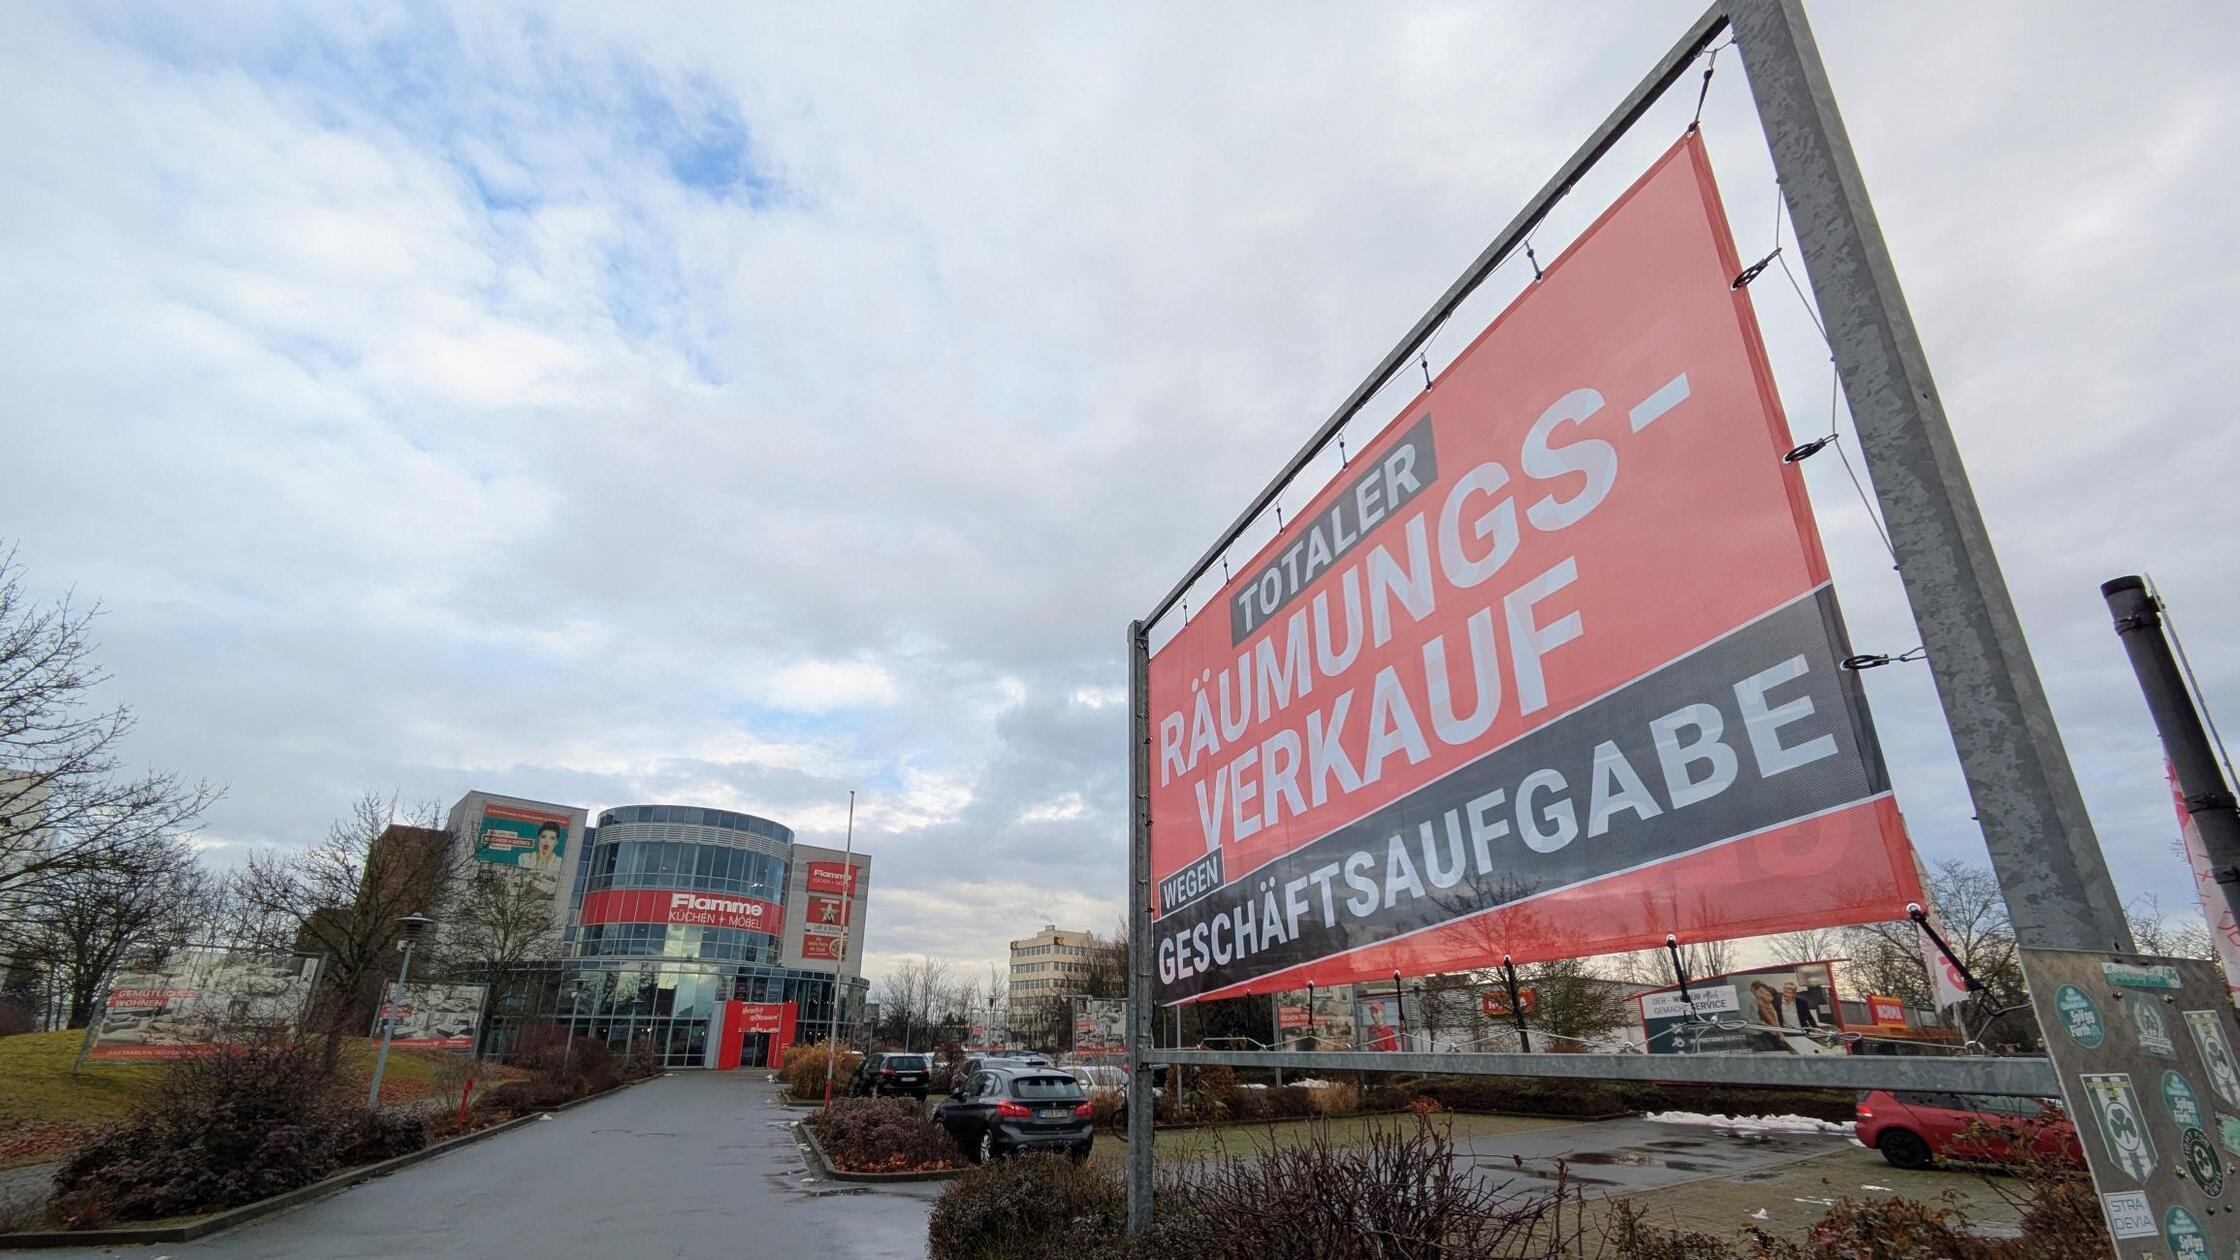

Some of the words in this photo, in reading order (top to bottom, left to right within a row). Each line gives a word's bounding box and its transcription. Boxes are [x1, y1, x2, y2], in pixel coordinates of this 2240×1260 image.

[1238, 443, 1421, 633] TOTALER
[1160, 371, 1691, 788] RÄUMUNGS-
[1194, 554, 1584, 853] VERKAUF
[1159, 653, 1839, 985] GESCHÄFTSAUFGABE
[670, 893, 763, 917] Flamme
[1163, 855, 1218, 909] WEGEN
[668, 909, 715, 924] KÜCHEN
[728, 914, 761, 929] MÖBEL
[115, 999, 163, 1008] WOHNEN
[2110, 1199, 2145, 1212] STRA
